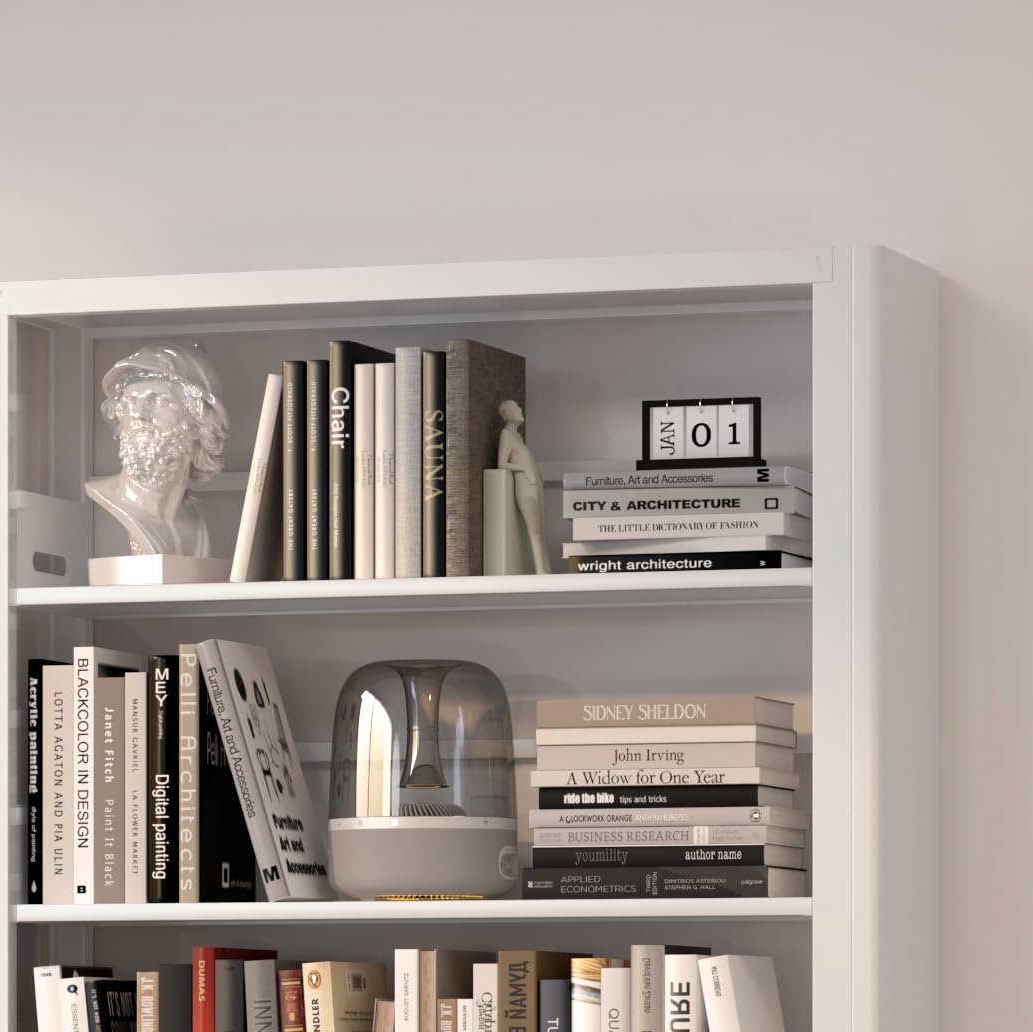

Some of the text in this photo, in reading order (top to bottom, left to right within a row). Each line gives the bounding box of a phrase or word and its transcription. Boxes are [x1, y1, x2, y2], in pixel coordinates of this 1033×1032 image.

[331, 386, 350, 449] Chair
[660, 421, 675, 456] JAN
[424, 409, 444, 502] SAUNA
[585, 473, 714, 487] Furniture, Art and Accessories
[572, 498, 741, 511] CITY & ARCHITECTURE
[598, 520, 759, 533] THE LITTLE DICTIONARY OF FASHION
[577, 557, 713, 573] wright architecture
[582, 703, 707, 722] SIDNEY SHELDON
[77, 658, 89, 849] BLACKCOLOR IN DESIGN
[612, 748, 685, 766] John Irving
[180, 653, 197, 891] Pelli Architects
[567, 769, 725, 785] A Widow for One Year
[54, 691, 64, 875] LOTTA AGATON AND PIA ULIN
[104, 706, 114, 887] Janet Fitch Paint It Black
[619, 796, 633, 804] tips
[648, 795, 667, 803] tricks
[152, 774, 169, 880] Digital painting
[567, 831, 624, 843] BUSINESS
[626, 830, 690, 842] RESEARCH
[685, 850, 742, 861] author name
[560, 875, 601, 884] APPLIED
[560, 885, 637, 894] ECONOMETRICS
[198, 959, 206, 1003] DUMAS
